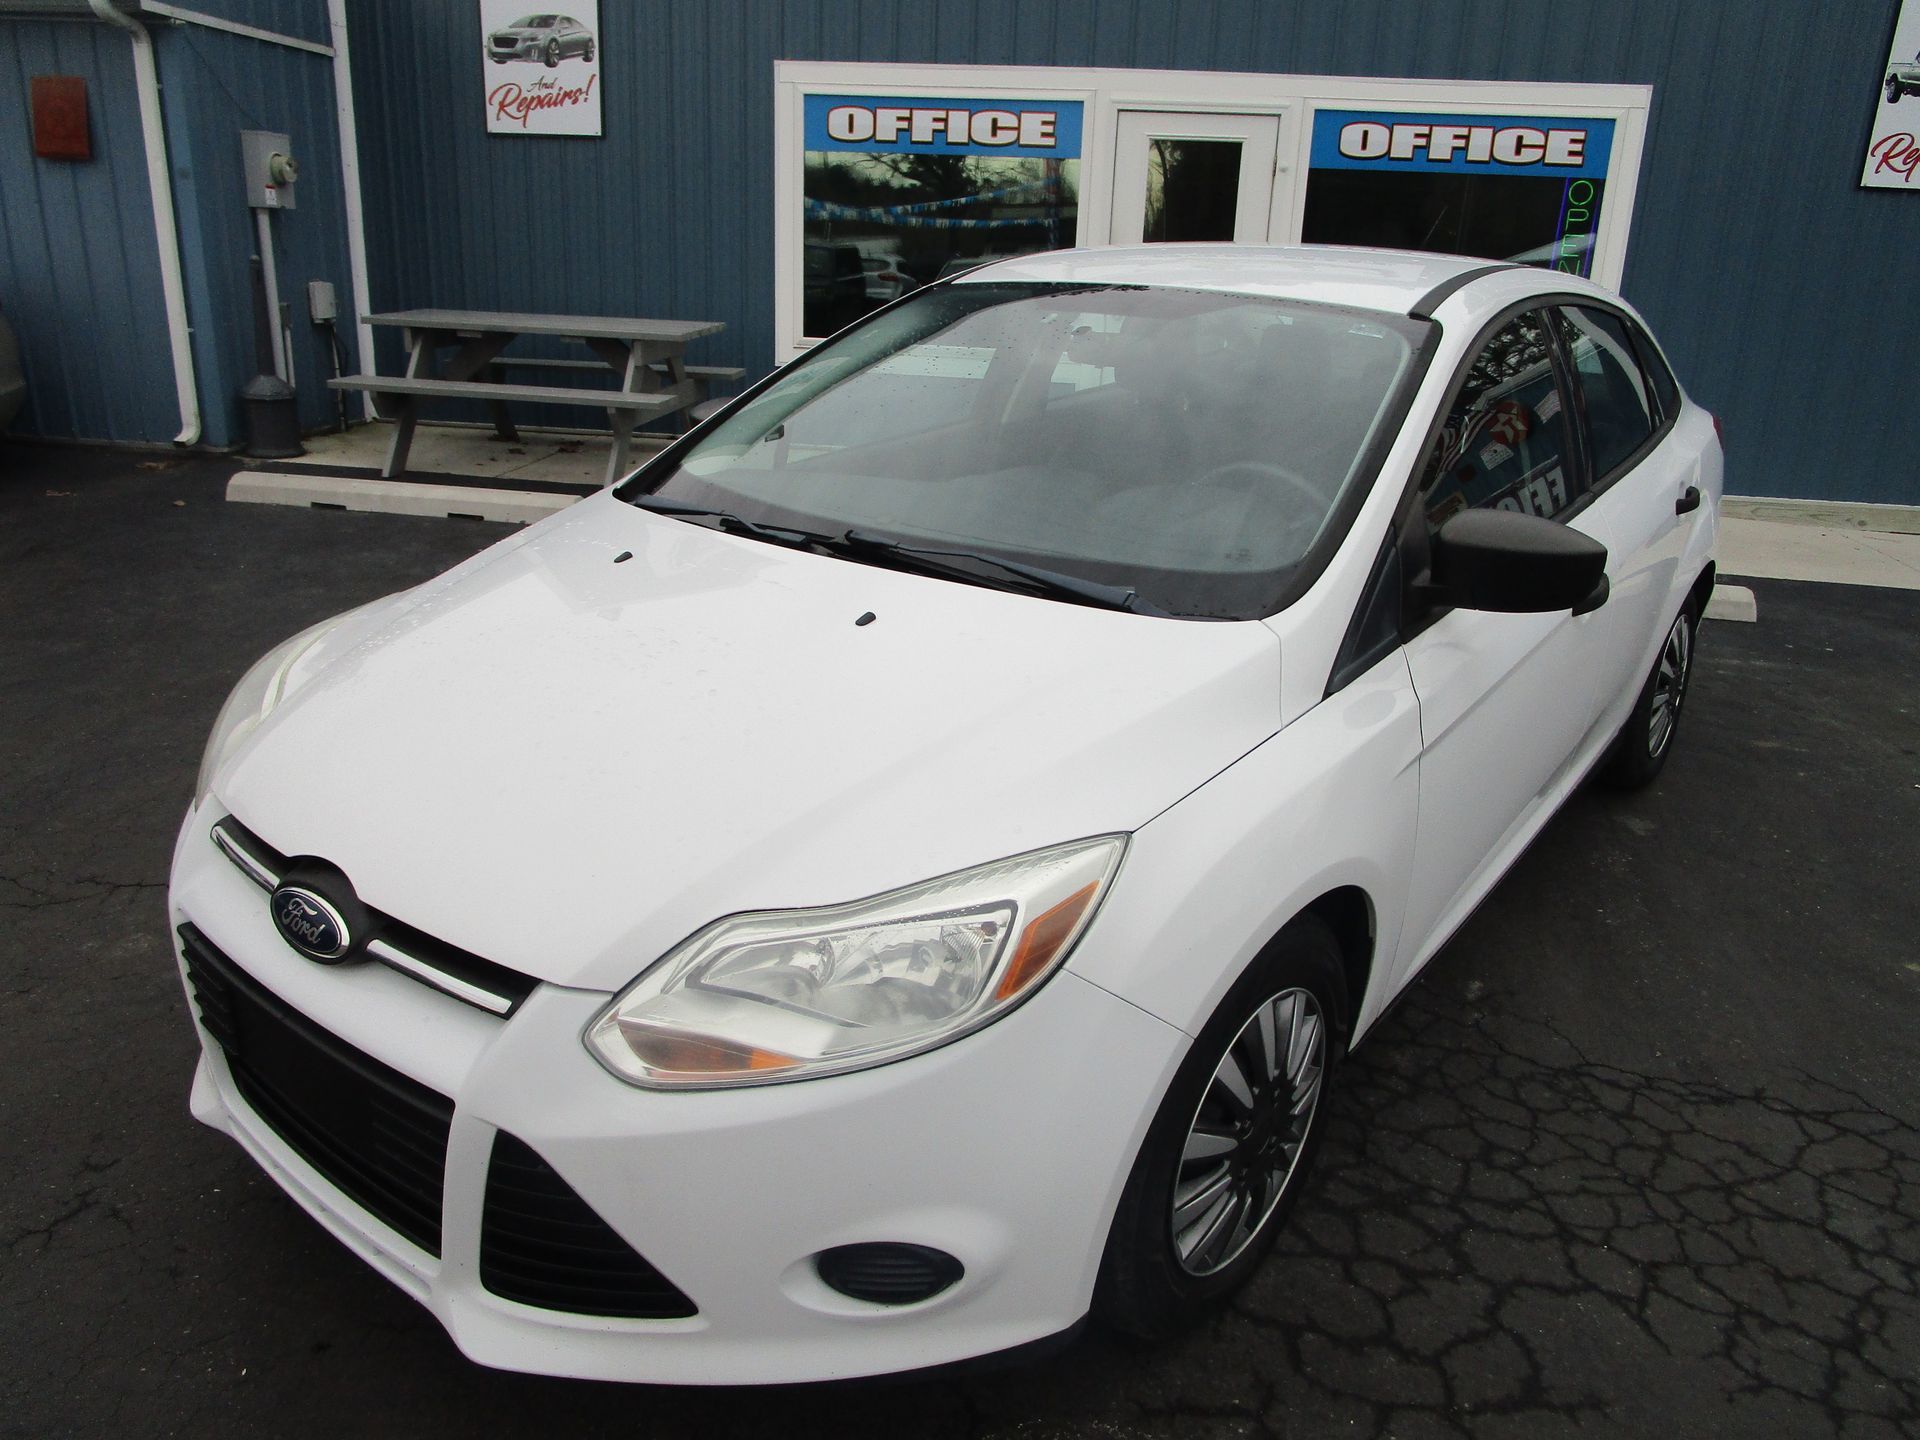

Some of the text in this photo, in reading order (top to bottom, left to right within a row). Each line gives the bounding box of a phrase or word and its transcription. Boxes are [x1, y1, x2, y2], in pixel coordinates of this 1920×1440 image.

[488, 73, 596, 128] Repairs!
[527, 75, 558, 92] And
[827, 105, 1057, 148] OFFICE
[1339, 121, 1587, 167] OFFICE
[1558, 180, 1594, 276] OPEN
[281, 897, 326, 944] Ford
